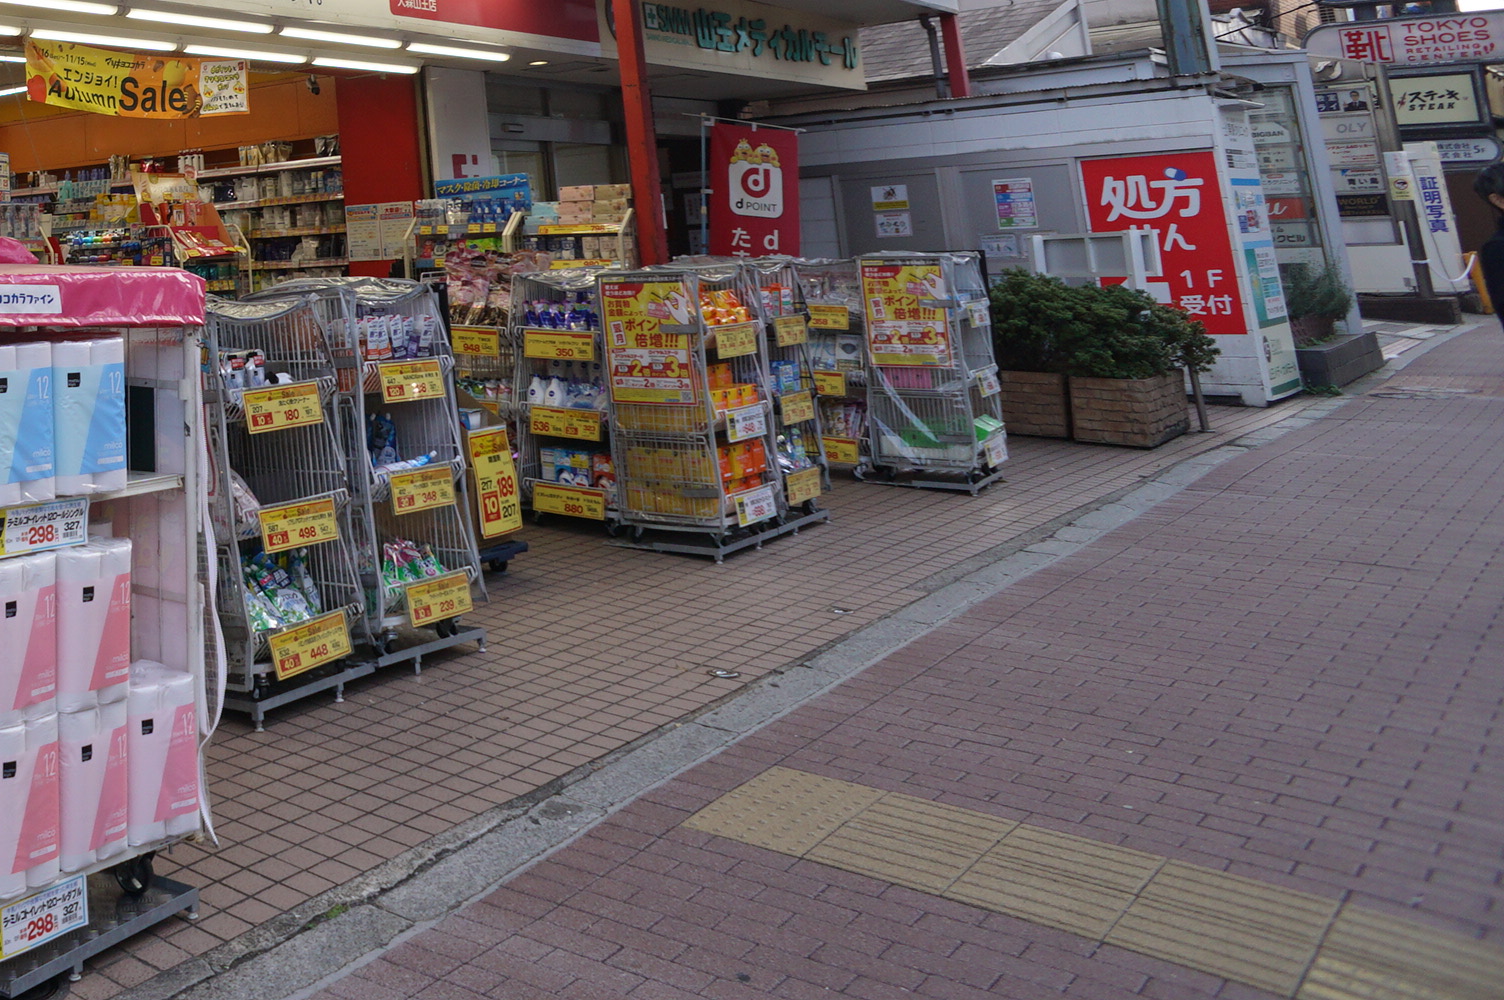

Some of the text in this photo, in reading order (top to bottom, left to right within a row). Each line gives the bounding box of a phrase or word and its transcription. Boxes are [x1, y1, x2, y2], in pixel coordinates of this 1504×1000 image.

[1400, 16, 1489, 36] TOKYO
[693, 7, 859, 71] 山王メディカルモール
[1344, 29, 1391, 63] 靴
[1403, 29, 1491, 48] SHOES
[1406, 42, 1481, 55] RETAILING
[1407, 50, 1483, 63] CENTER
[62, 67, 119, 89] エンジョイ!
[47, 79, 117, 109] Autumn
[119, 76, 187, 113] Sale
[1407, 88, 1461, 103] ステーキ
[1408, 101, 1456, 112] STEAK
[1336, 122, 1367, 133] OLY
[436, 176, 528, 196] マスク・除菌・冷却コーナー
[745, 201, 779, 213] POINT
[1100, 174, 1204, 222] 処方
[1418, 176, 1450, 233] 証明写真
[1179, 294, 1233, 316] 受付
[462, 342, 481, 353] 948
[634, 333, 680, 348] 倍増!!!
[556, 347, 574, 357] 350
[36, 375, 49, 399] 12
[109, 371, 122, 395] 12
[257, 408, 300, 425] 10 180
[532, 420, 550, 432] 536
[481, 475, 514, 498] 217 189
[421, 491, 437, 503] 348
[484, 496, 516, 519] 10 207
[564, 503, 584, 514] 880
[28, 520, 81, 545] 298 327
[271, 534, 283, 545] 40
[298, 525, 317, 539] 498
[439, 599, 455, 613] 239
[283, 660, 295, 670] 40
[309, 643, 329, 660] 448
[27, 901, 79, 942] 298 327
